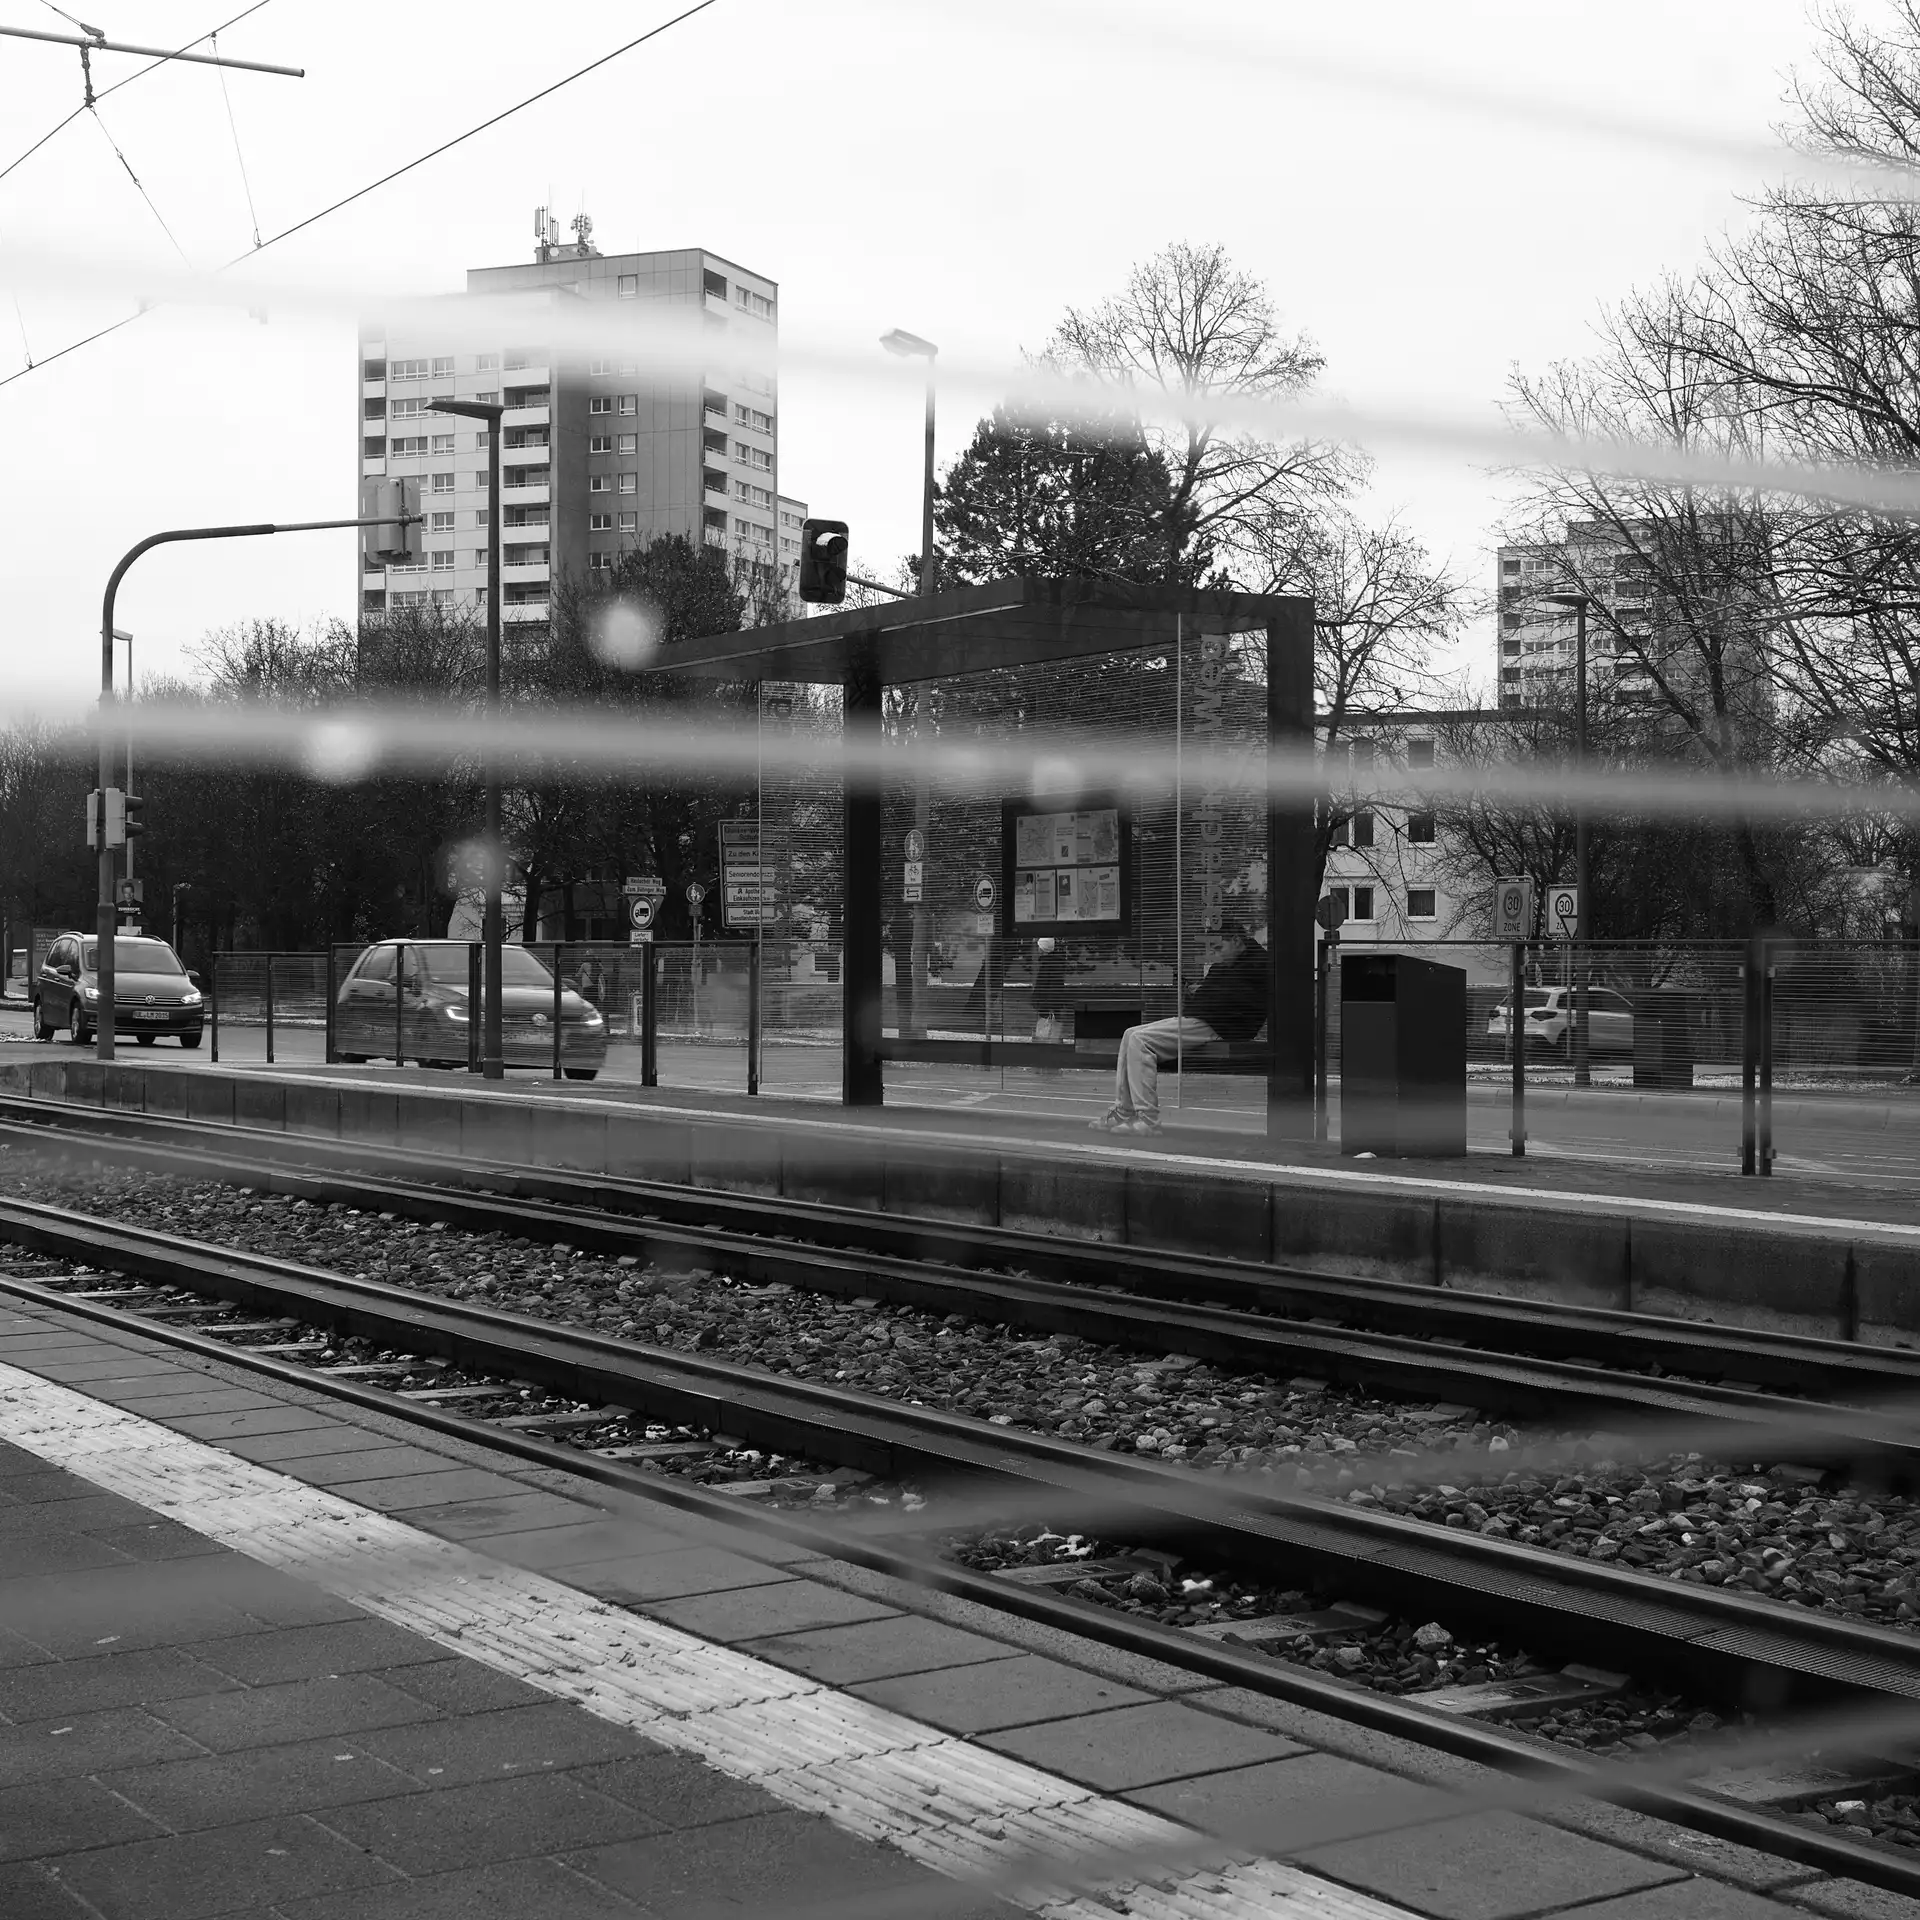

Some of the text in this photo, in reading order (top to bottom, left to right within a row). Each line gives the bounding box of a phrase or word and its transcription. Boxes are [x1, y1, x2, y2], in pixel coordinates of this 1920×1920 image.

[1194, 634, 1229, 732] Weg
[1507, 896, 1519, 910] 30
[1558, 900, 1570, 913] 30
[1503, 922, 1521, 932] ZONE
